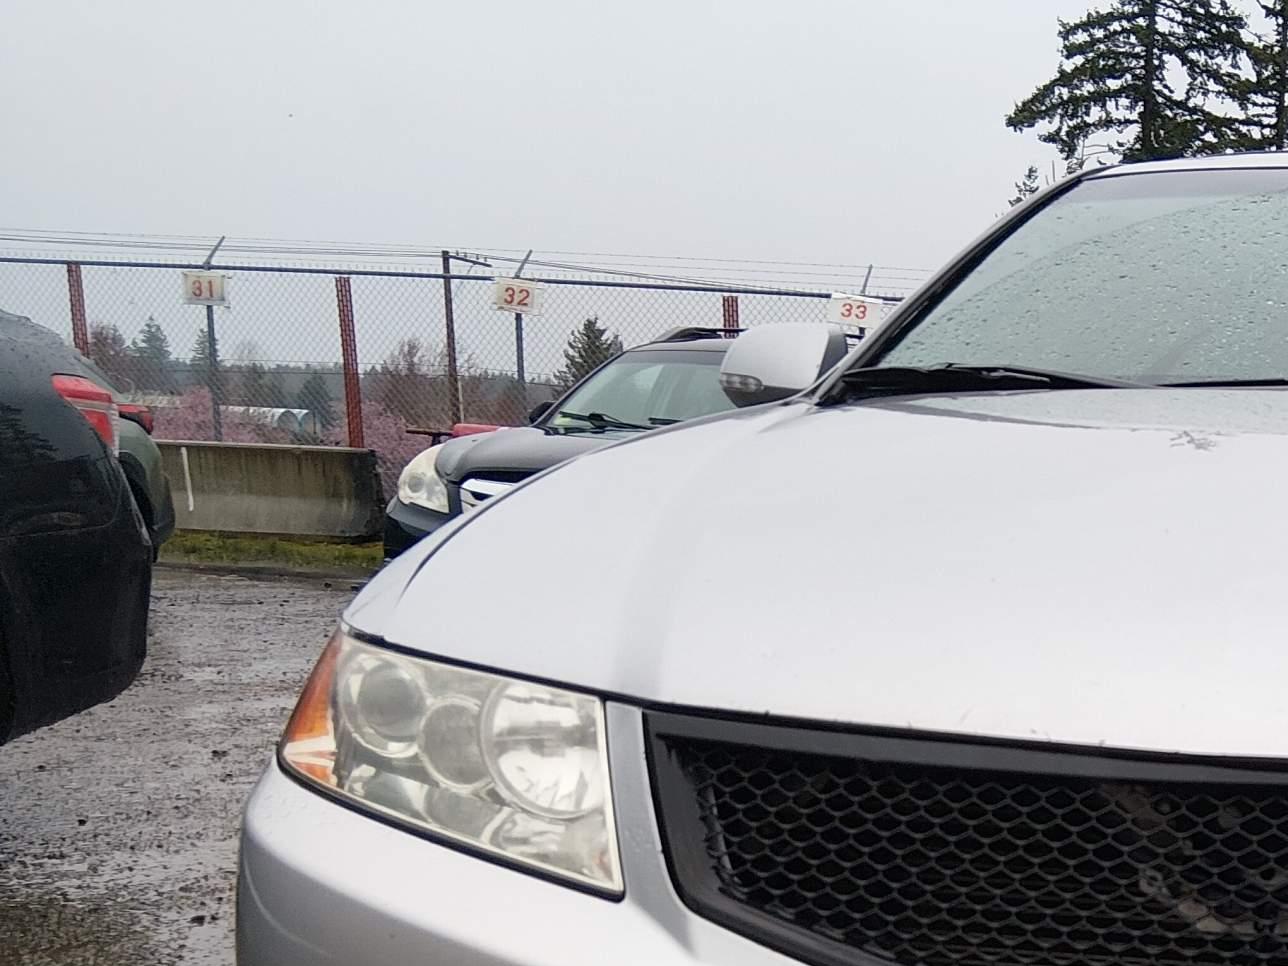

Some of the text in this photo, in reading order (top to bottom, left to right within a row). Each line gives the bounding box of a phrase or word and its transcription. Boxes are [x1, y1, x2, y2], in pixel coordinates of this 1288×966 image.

[191, 279, 214, 298] 31
[503, 286, 530, 306] 32
[840, 302, 867, 320] 33
